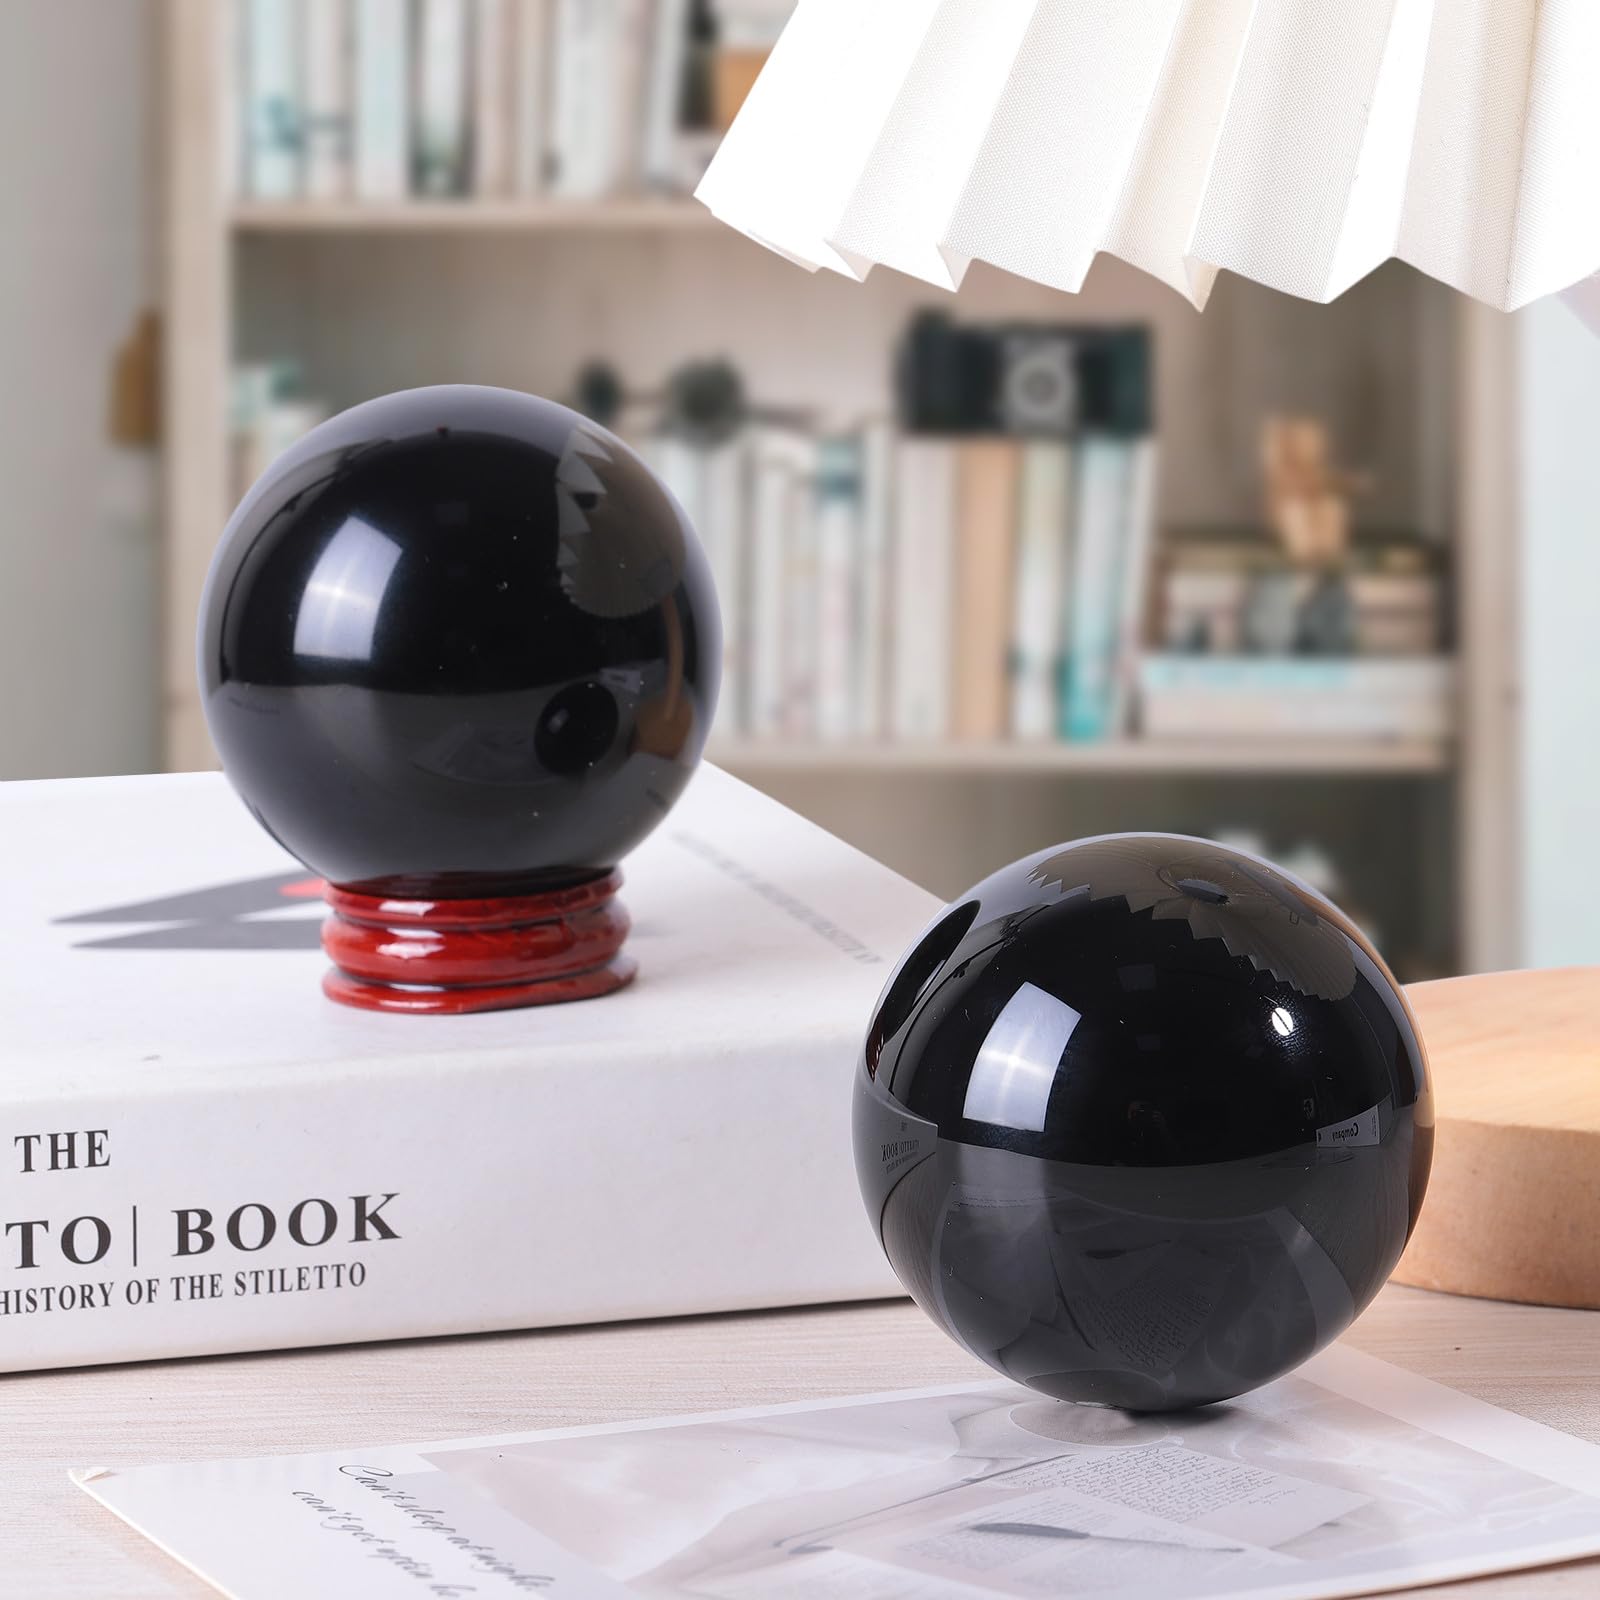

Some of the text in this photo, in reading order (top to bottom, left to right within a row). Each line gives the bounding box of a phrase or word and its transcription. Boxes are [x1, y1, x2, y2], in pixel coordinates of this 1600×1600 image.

[14, 1129, 111, 1173] THE
[170, 1192, 402, 1257] BOOK
[125, 1278, 161, 1306] OF
[170, 1273, 224, 1302] THE
[234, 1261, 367, 1298] STILETTO
